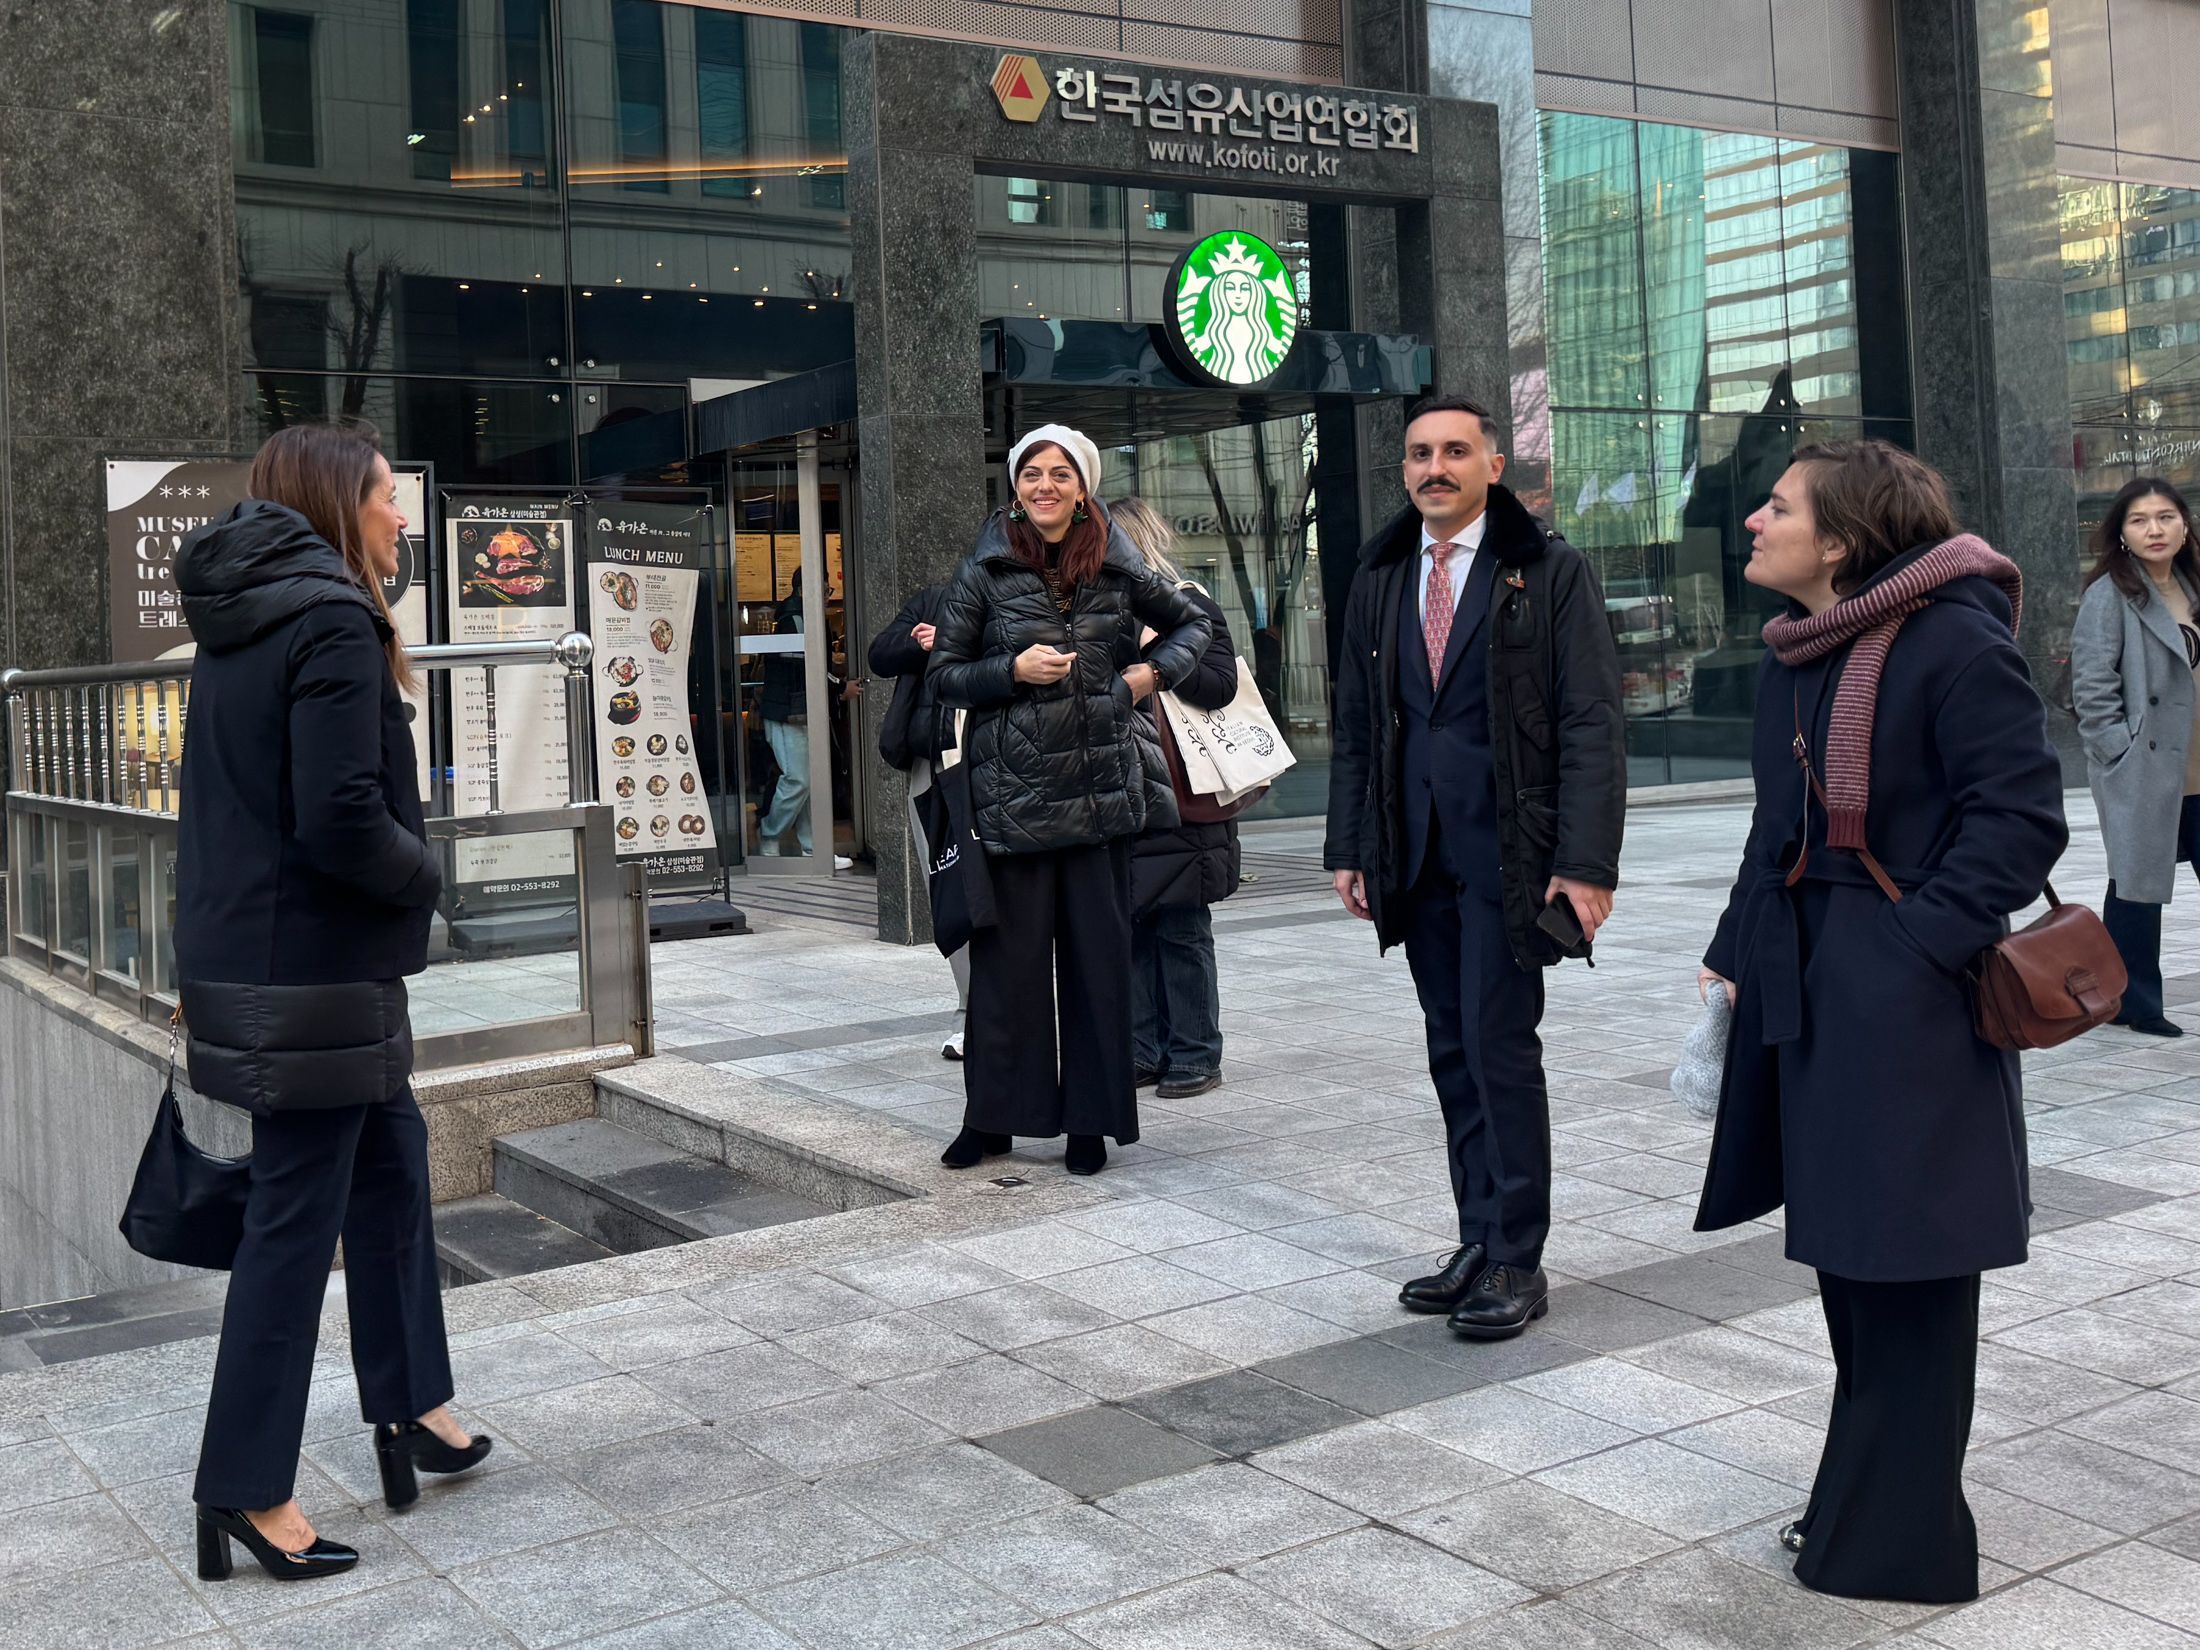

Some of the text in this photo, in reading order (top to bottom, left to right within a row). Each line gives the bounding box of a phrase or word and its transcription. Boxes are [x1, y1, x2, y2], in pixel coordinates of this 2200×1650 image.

[1055, 67, 1419, 154] 한국섬유산업연합회
[1148, 140, 1340, 178] www.kofoti.or.kr
[603, 545, 684, 565] LUNCH MENU
[510, 880, 560, 892] 02-553-8292
